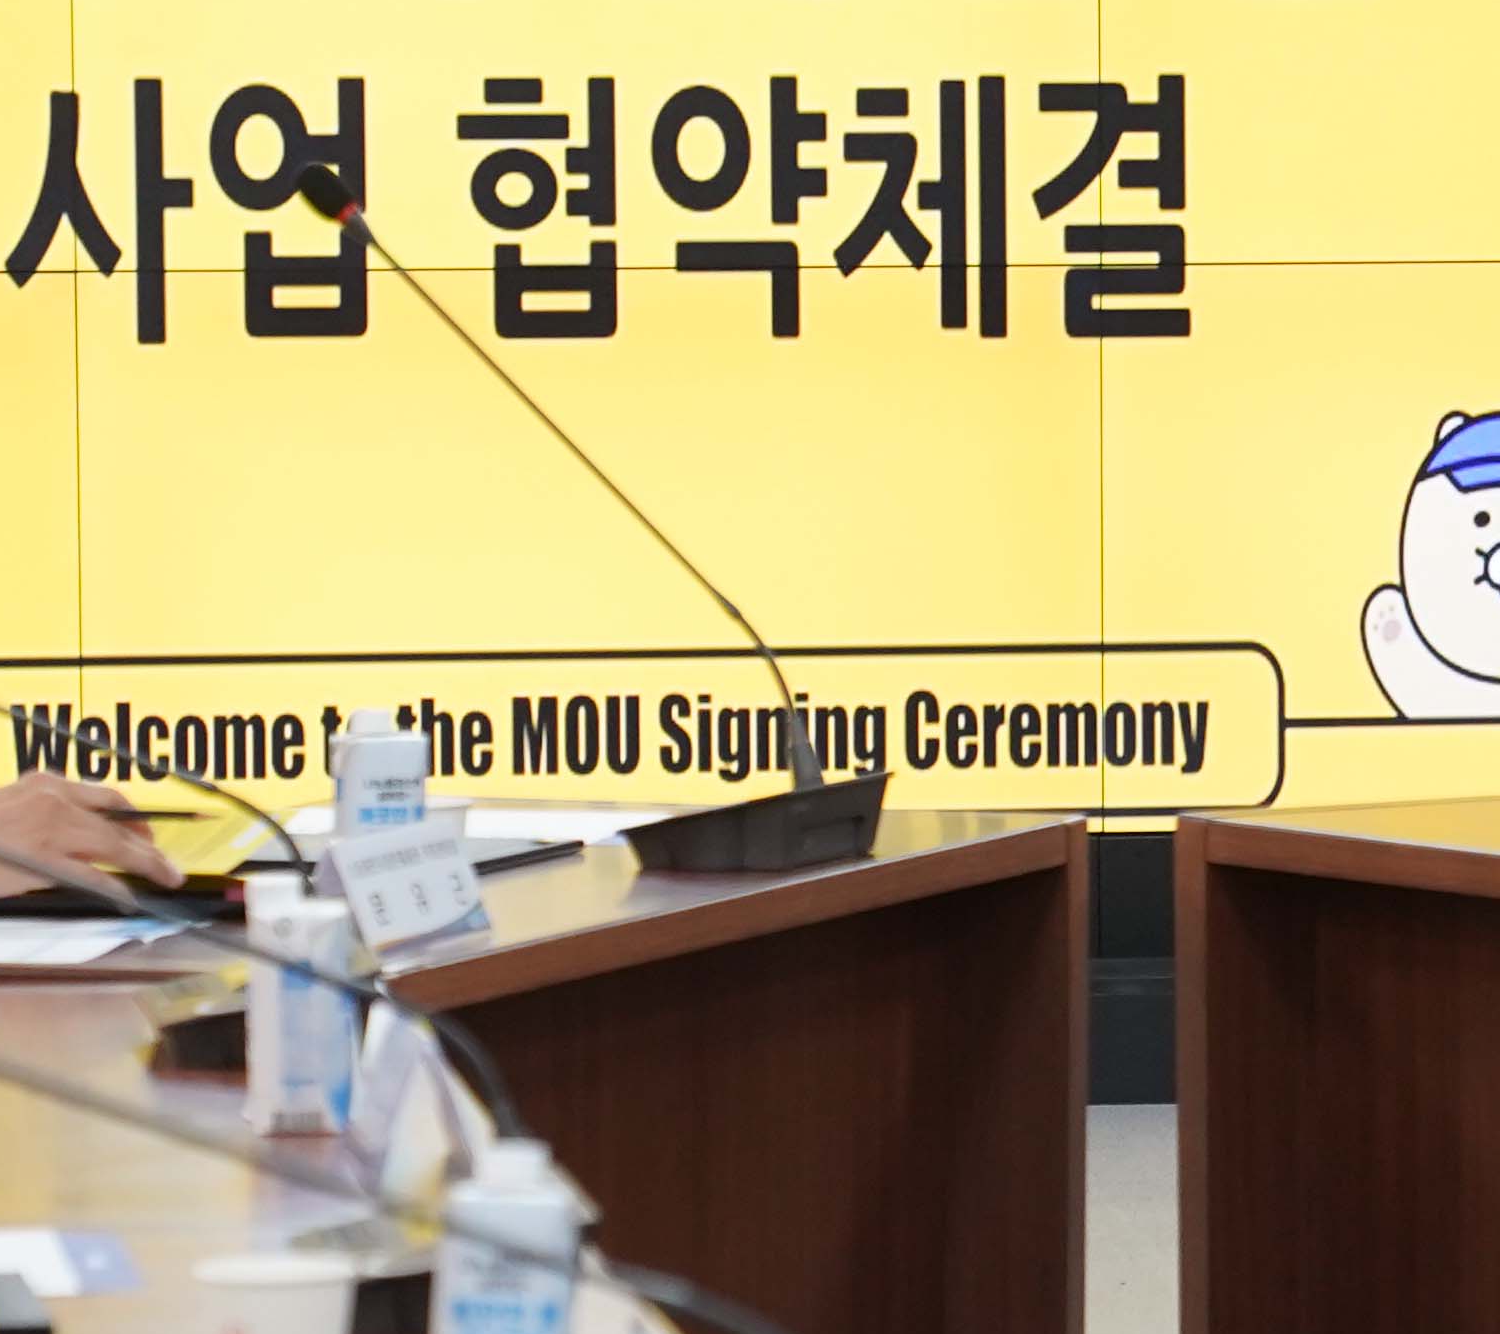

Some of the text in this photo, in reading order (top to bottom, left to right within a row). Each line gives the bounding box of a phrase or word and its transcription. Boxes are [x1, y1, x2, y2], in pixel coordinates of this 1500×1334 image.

[5, 74, 1192, 345] 사업 협약체결
[10, 702, 306, 783] Welcome
[512, 695, 640, 775] MOU
[905, 690, 1209, 774] Ceremony
